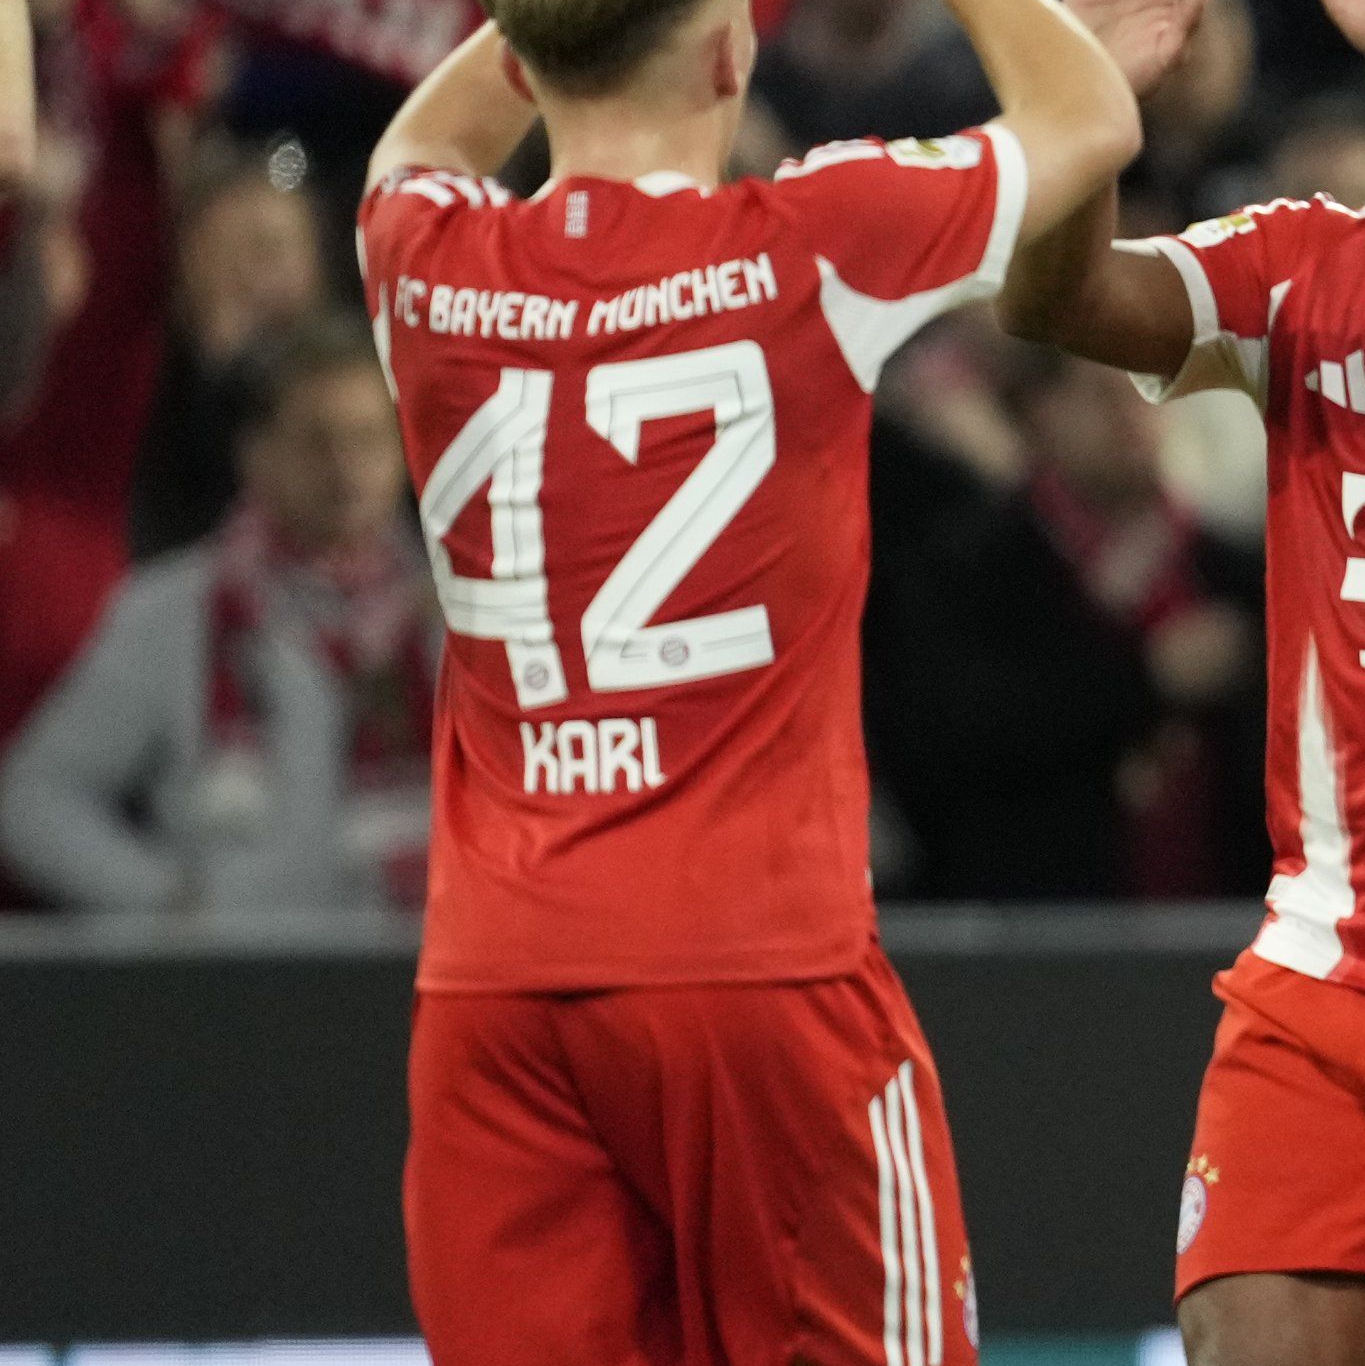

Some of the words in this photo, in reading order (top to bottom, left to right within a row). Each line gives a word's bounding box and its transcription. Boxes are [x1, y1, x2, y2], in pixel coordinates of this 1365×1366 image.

[428, 283, 580, 341] BAYERN
[586, 251, 778, 336] MÜNCHEN
[419, 339, 776, 711] 42
[519, 716, 668, 795] KARL
